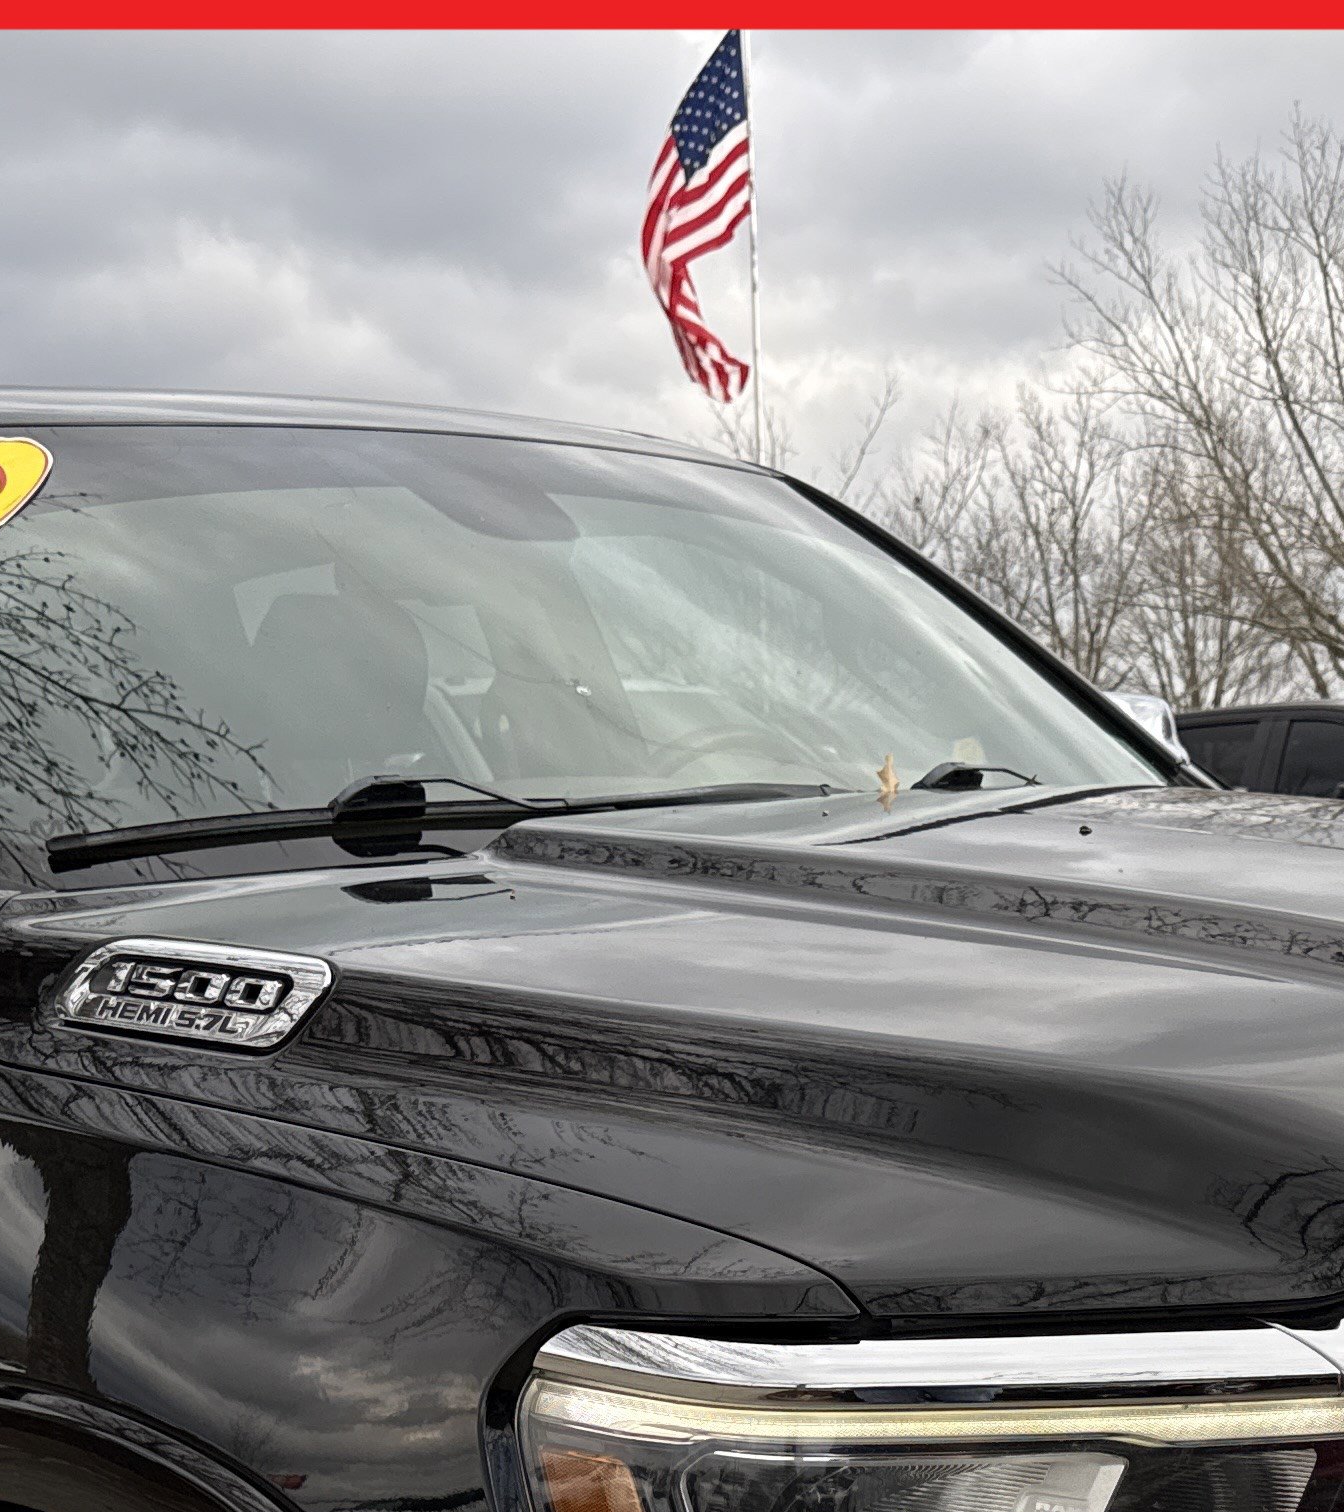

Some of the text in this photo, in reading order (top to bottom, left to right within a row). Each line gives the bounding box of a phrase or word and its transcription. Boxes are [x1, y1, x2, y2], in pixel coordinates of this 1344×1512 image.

[107, 962, 283, 1010] 1500
[97, 998, 240, 1035] HEMI 5.7L
